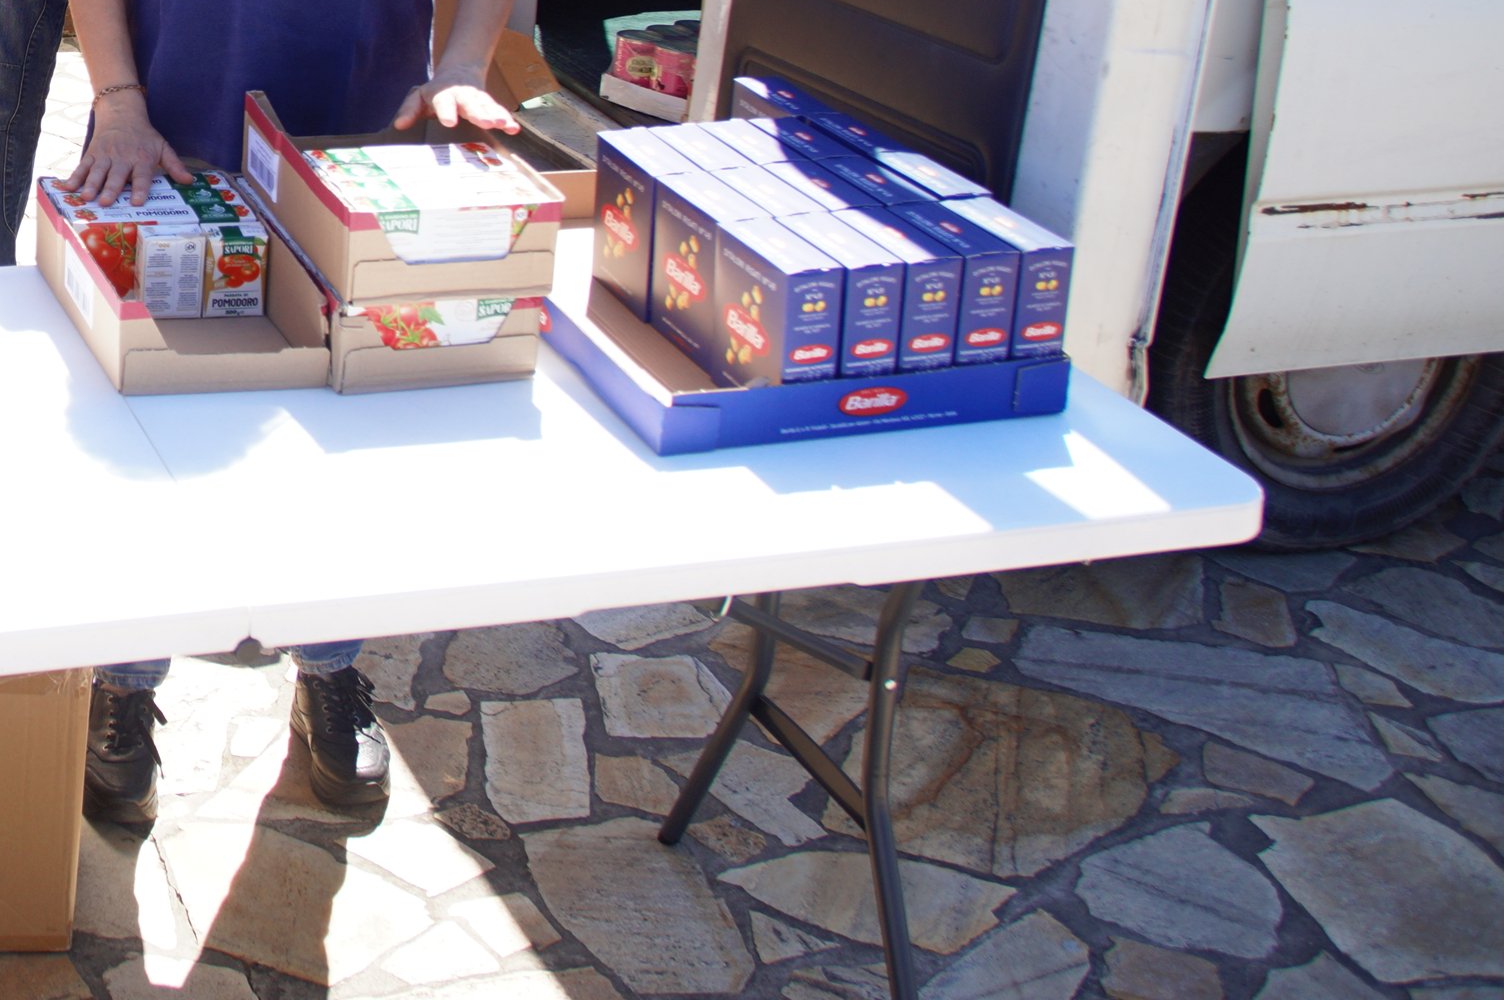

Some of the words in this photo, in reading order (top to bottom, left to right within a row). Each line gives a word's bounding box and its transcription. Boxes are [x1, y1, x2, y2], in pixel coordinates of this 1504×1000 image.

[211, 297, 259, 308] POMODORO
[478, 302, 512, 318] SAPOR
[726, 308, 766, 350] Barilla
[845, 392, 900, 411] Barilla
